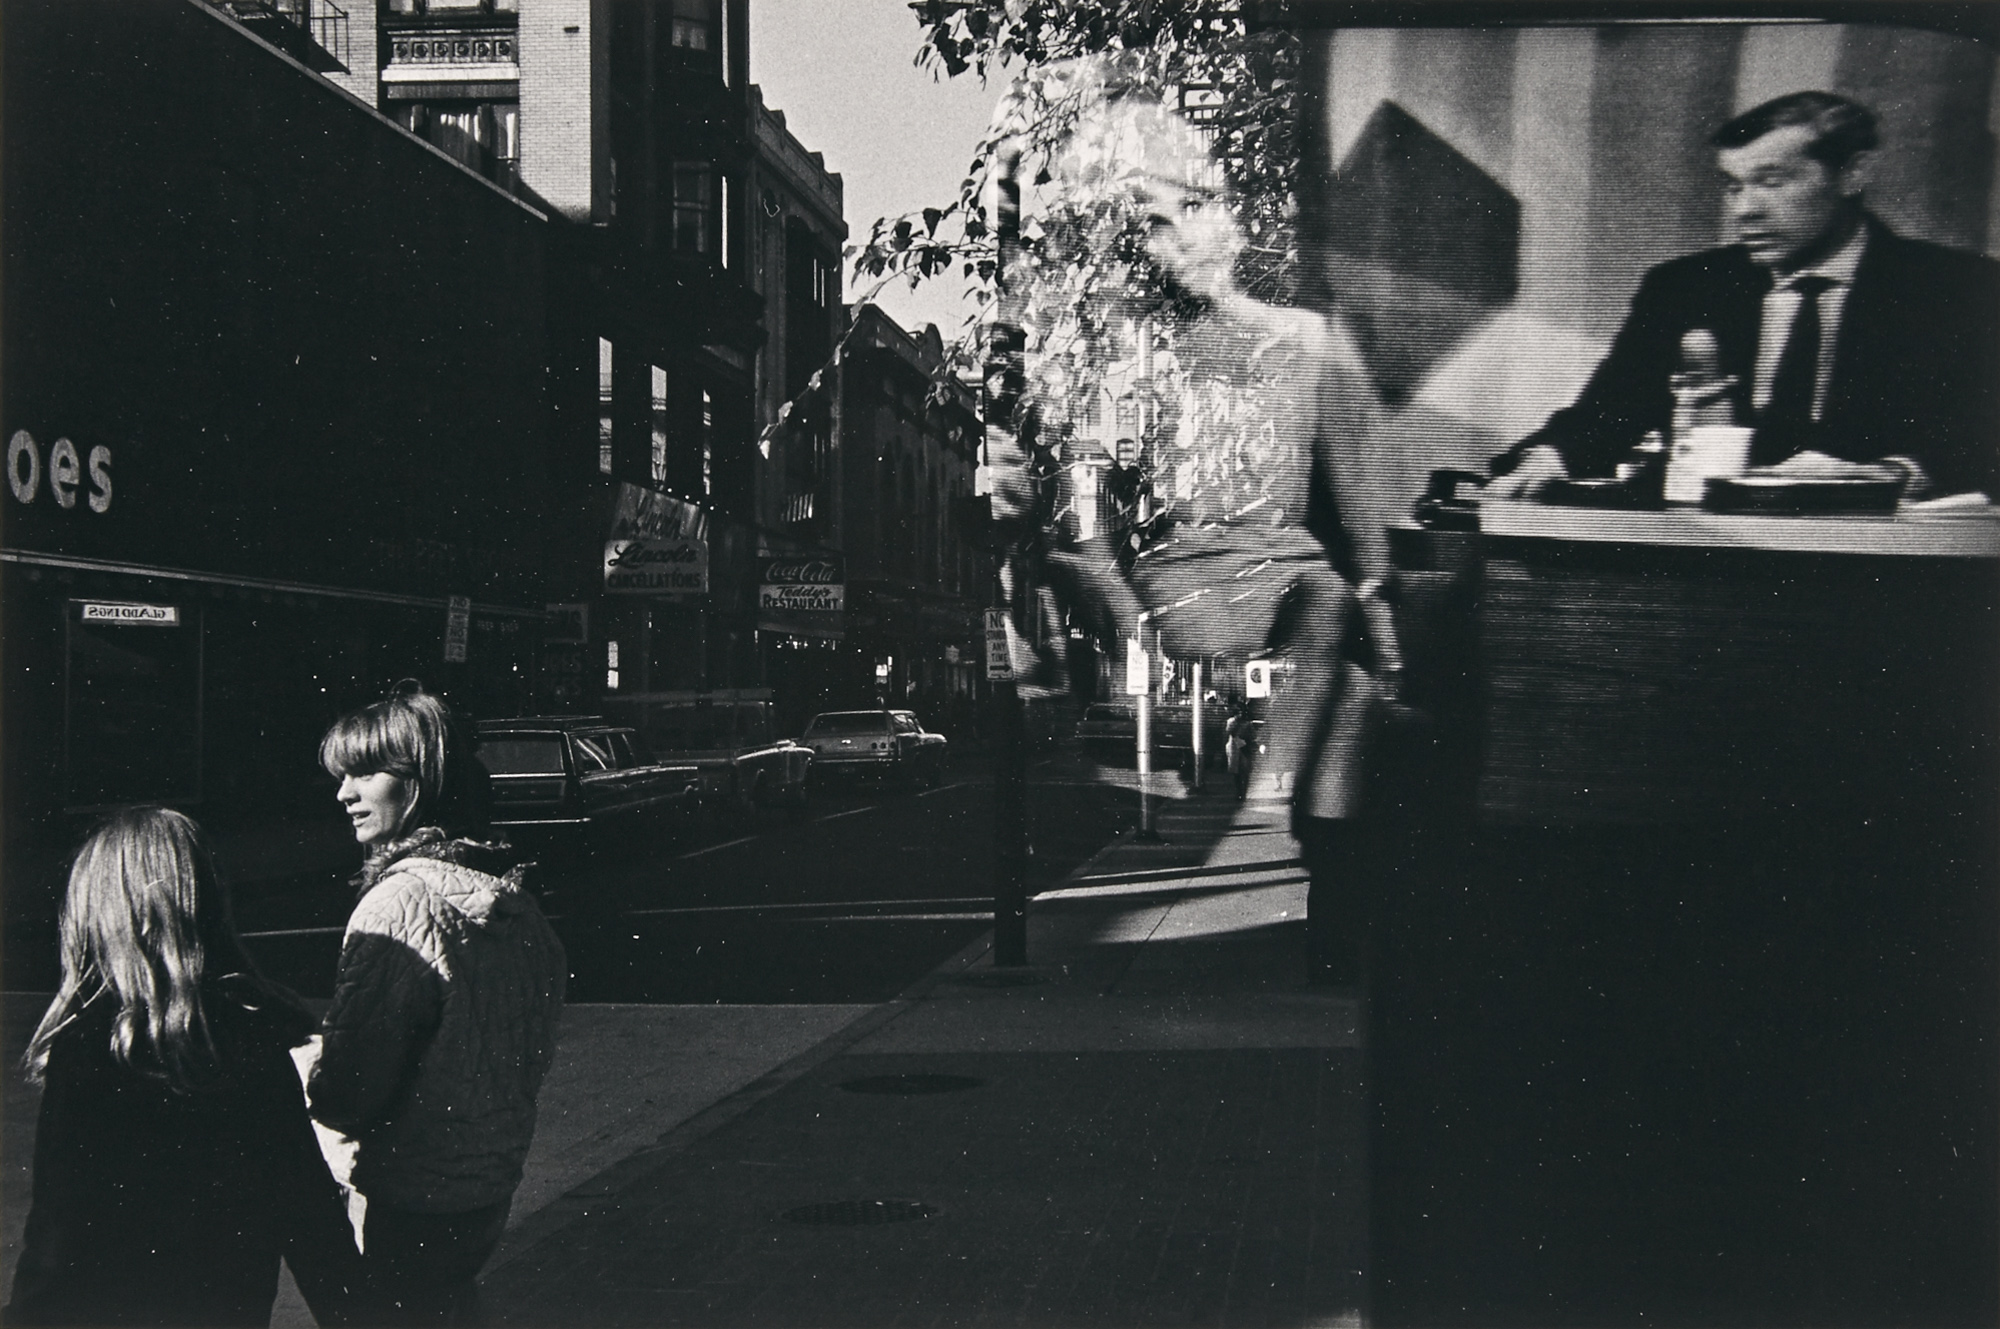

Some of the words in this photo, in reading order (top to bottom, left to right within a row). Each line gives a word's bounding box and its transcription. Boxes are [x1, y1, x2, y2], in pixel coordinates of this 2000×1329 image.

[608, 542, 698, 569] Lincoln
[607, 571, 701, 589] CANCELLATIONS
[777, 586, 833, 600] Teddy's
[763, 594, 839, 610] RESTAURANT
[992, 642, 1007, 651] ANY
[991, 653, 1008, 662] TIME
